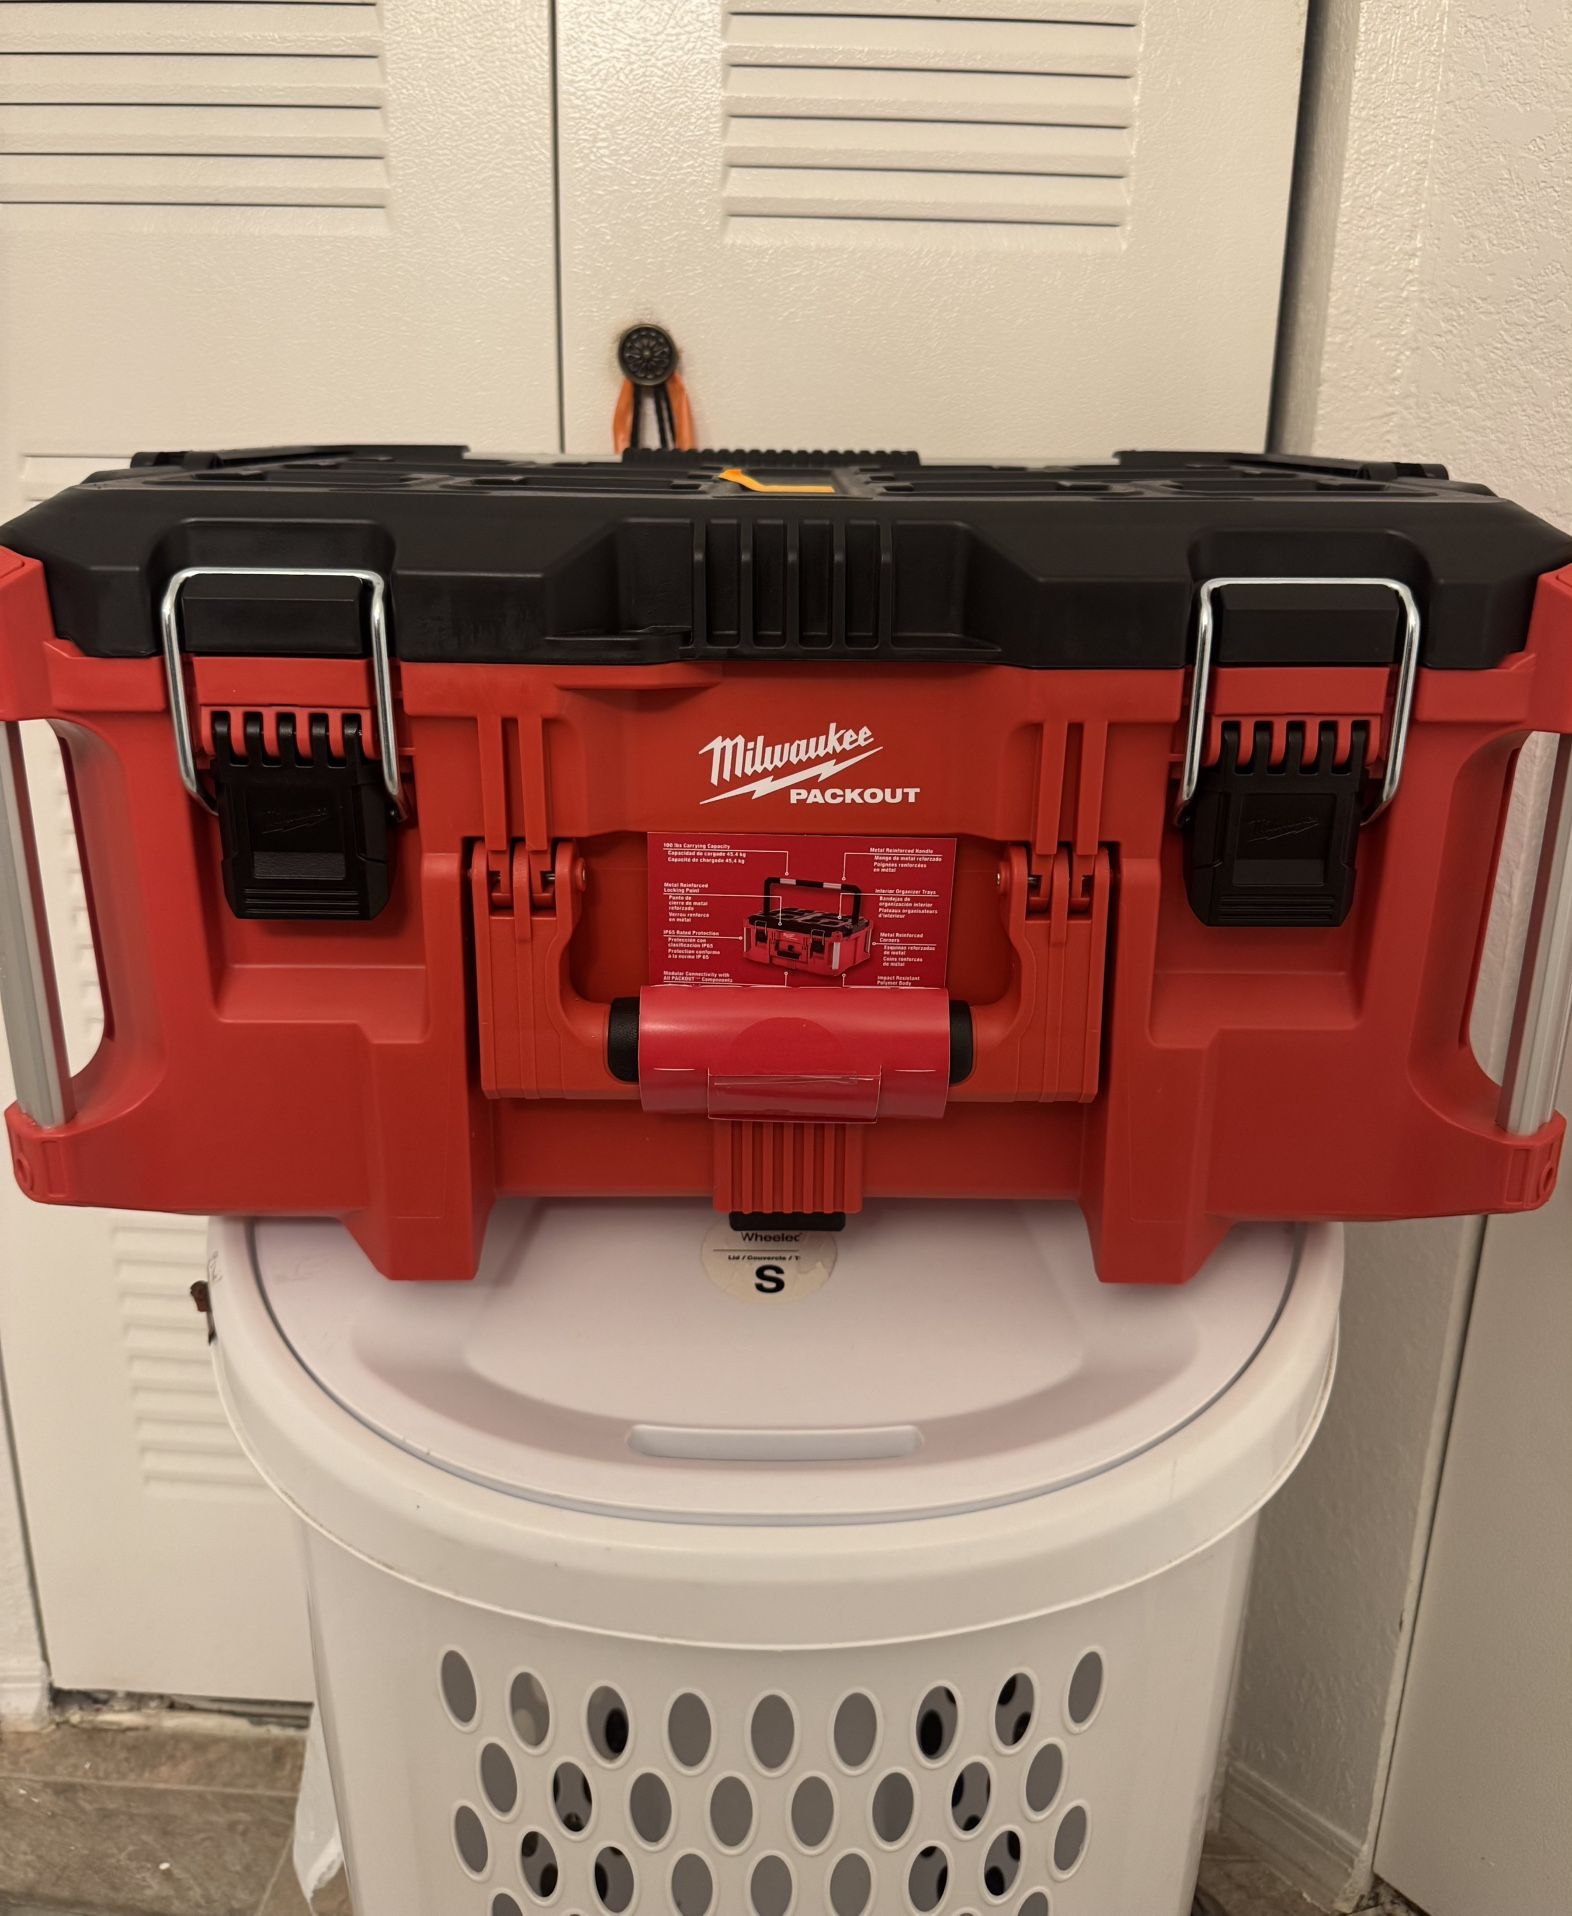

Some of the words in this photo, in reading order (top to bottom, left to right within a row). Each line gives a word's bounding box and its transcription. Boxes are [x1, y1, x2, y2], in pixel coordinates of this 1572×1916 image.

[699, 722, 874, 786] Milwaukee
[790, 788, 920, 804] PACKOUT
[755, 1265, 785, 1293] S
